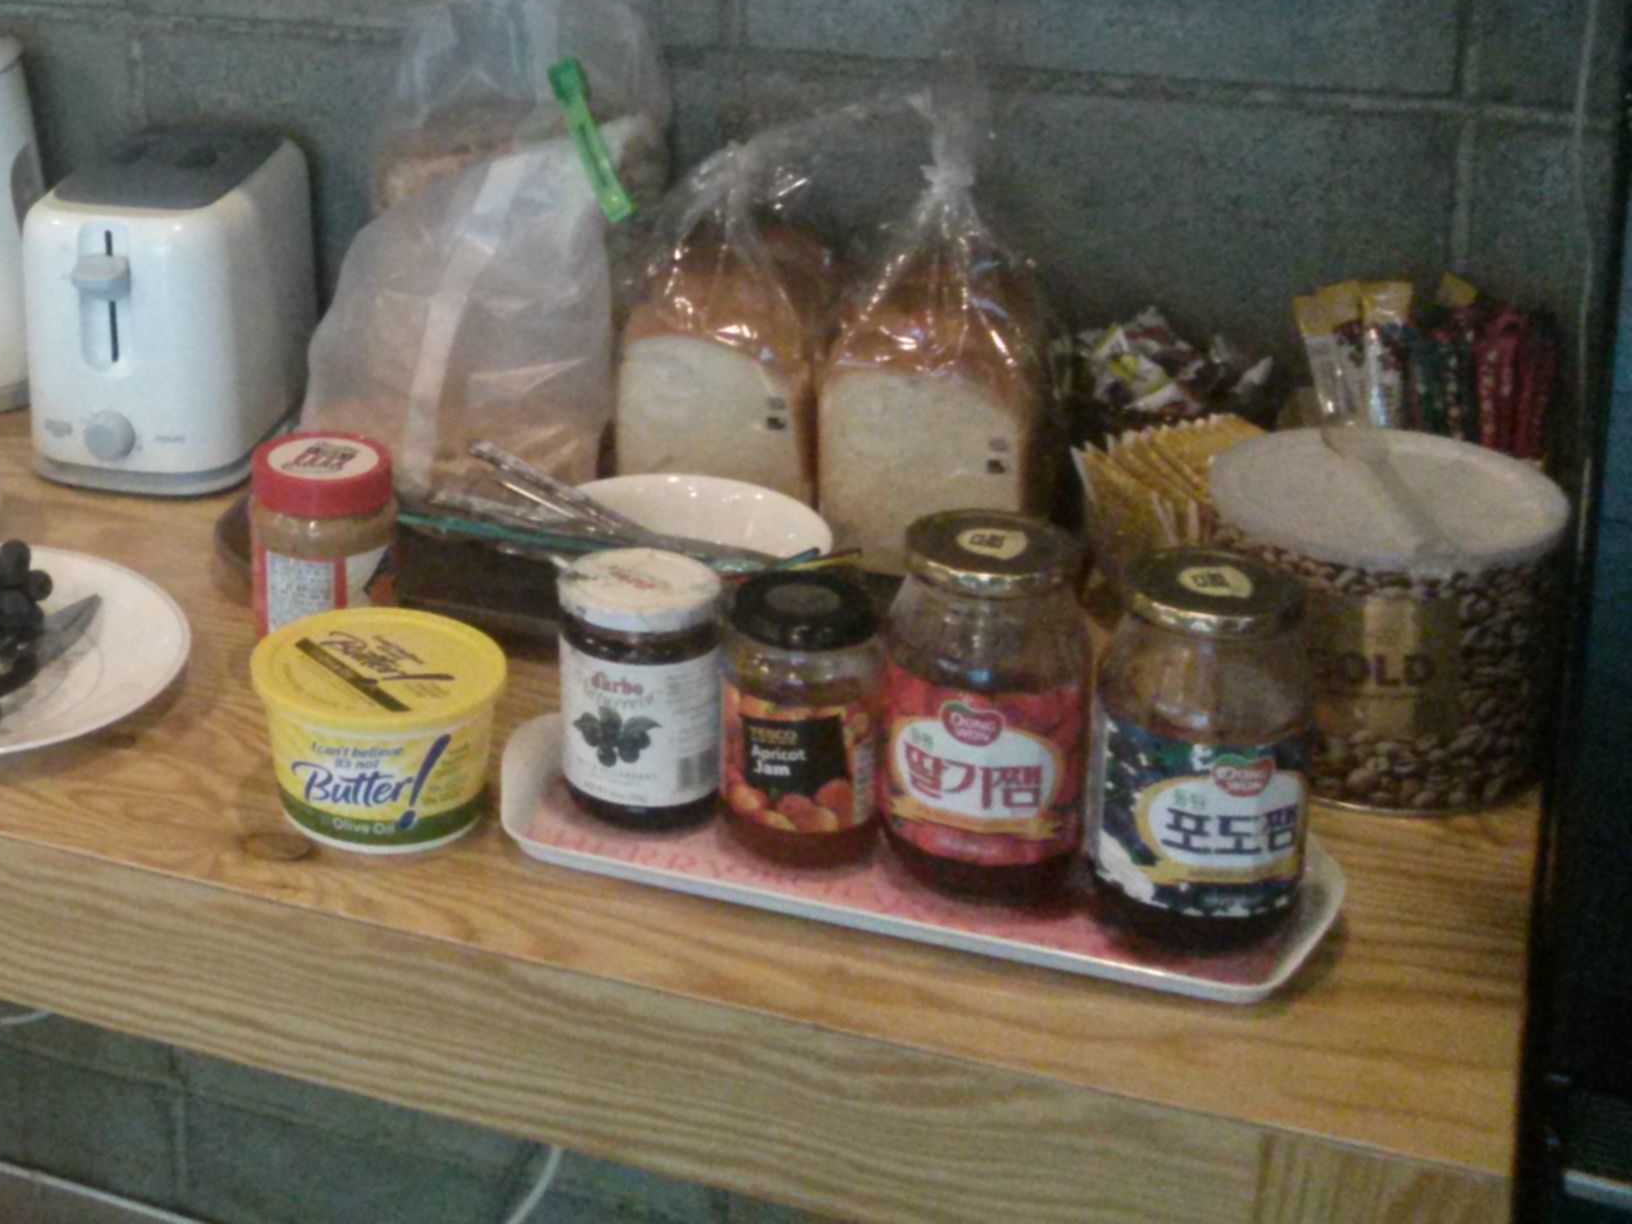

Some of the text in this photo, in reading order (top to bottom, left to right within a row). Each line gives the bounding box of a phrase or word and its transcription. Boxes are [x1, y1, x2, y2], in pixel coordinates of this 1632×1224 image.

[751, 743, 807, 762] Apricot
[355, 759, 380, 770] not
[753, 758, 792, 777] Jam
